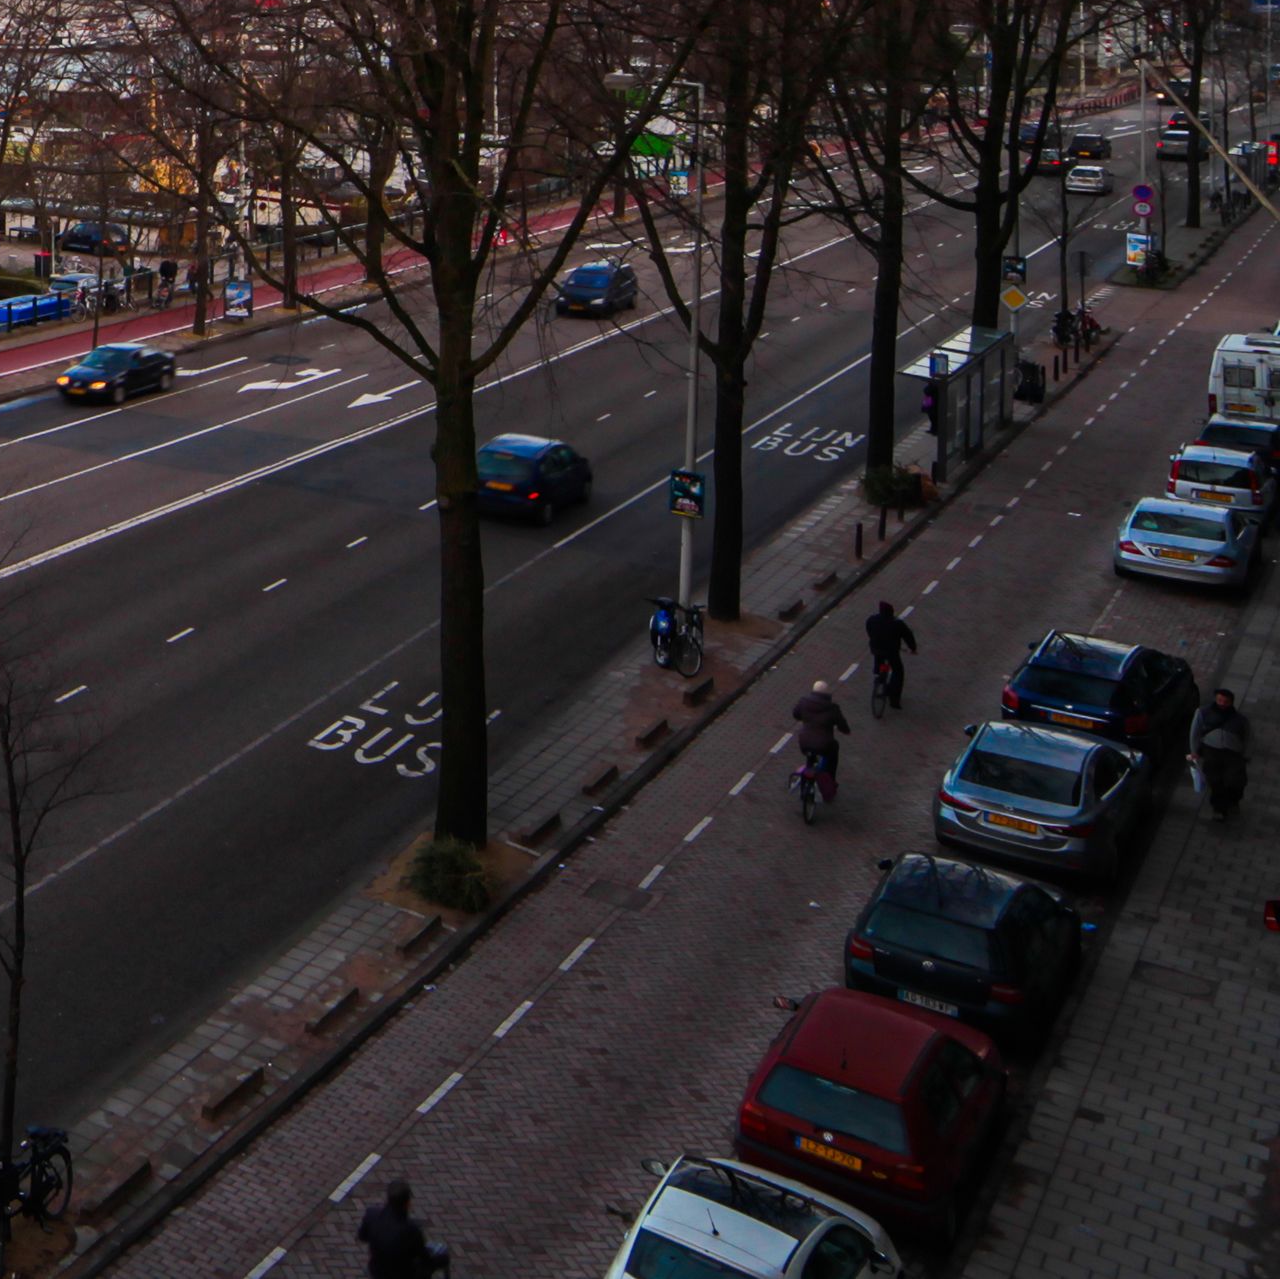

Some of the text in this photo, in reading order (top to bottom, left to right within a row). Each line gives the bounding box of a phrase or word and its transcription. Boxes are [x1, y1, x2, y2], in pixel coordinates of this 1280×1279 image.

[772, 422, 866, 447] LIJN
[750, 436, 845, 461] BUS
[306, 715, 443, 777] BUS
